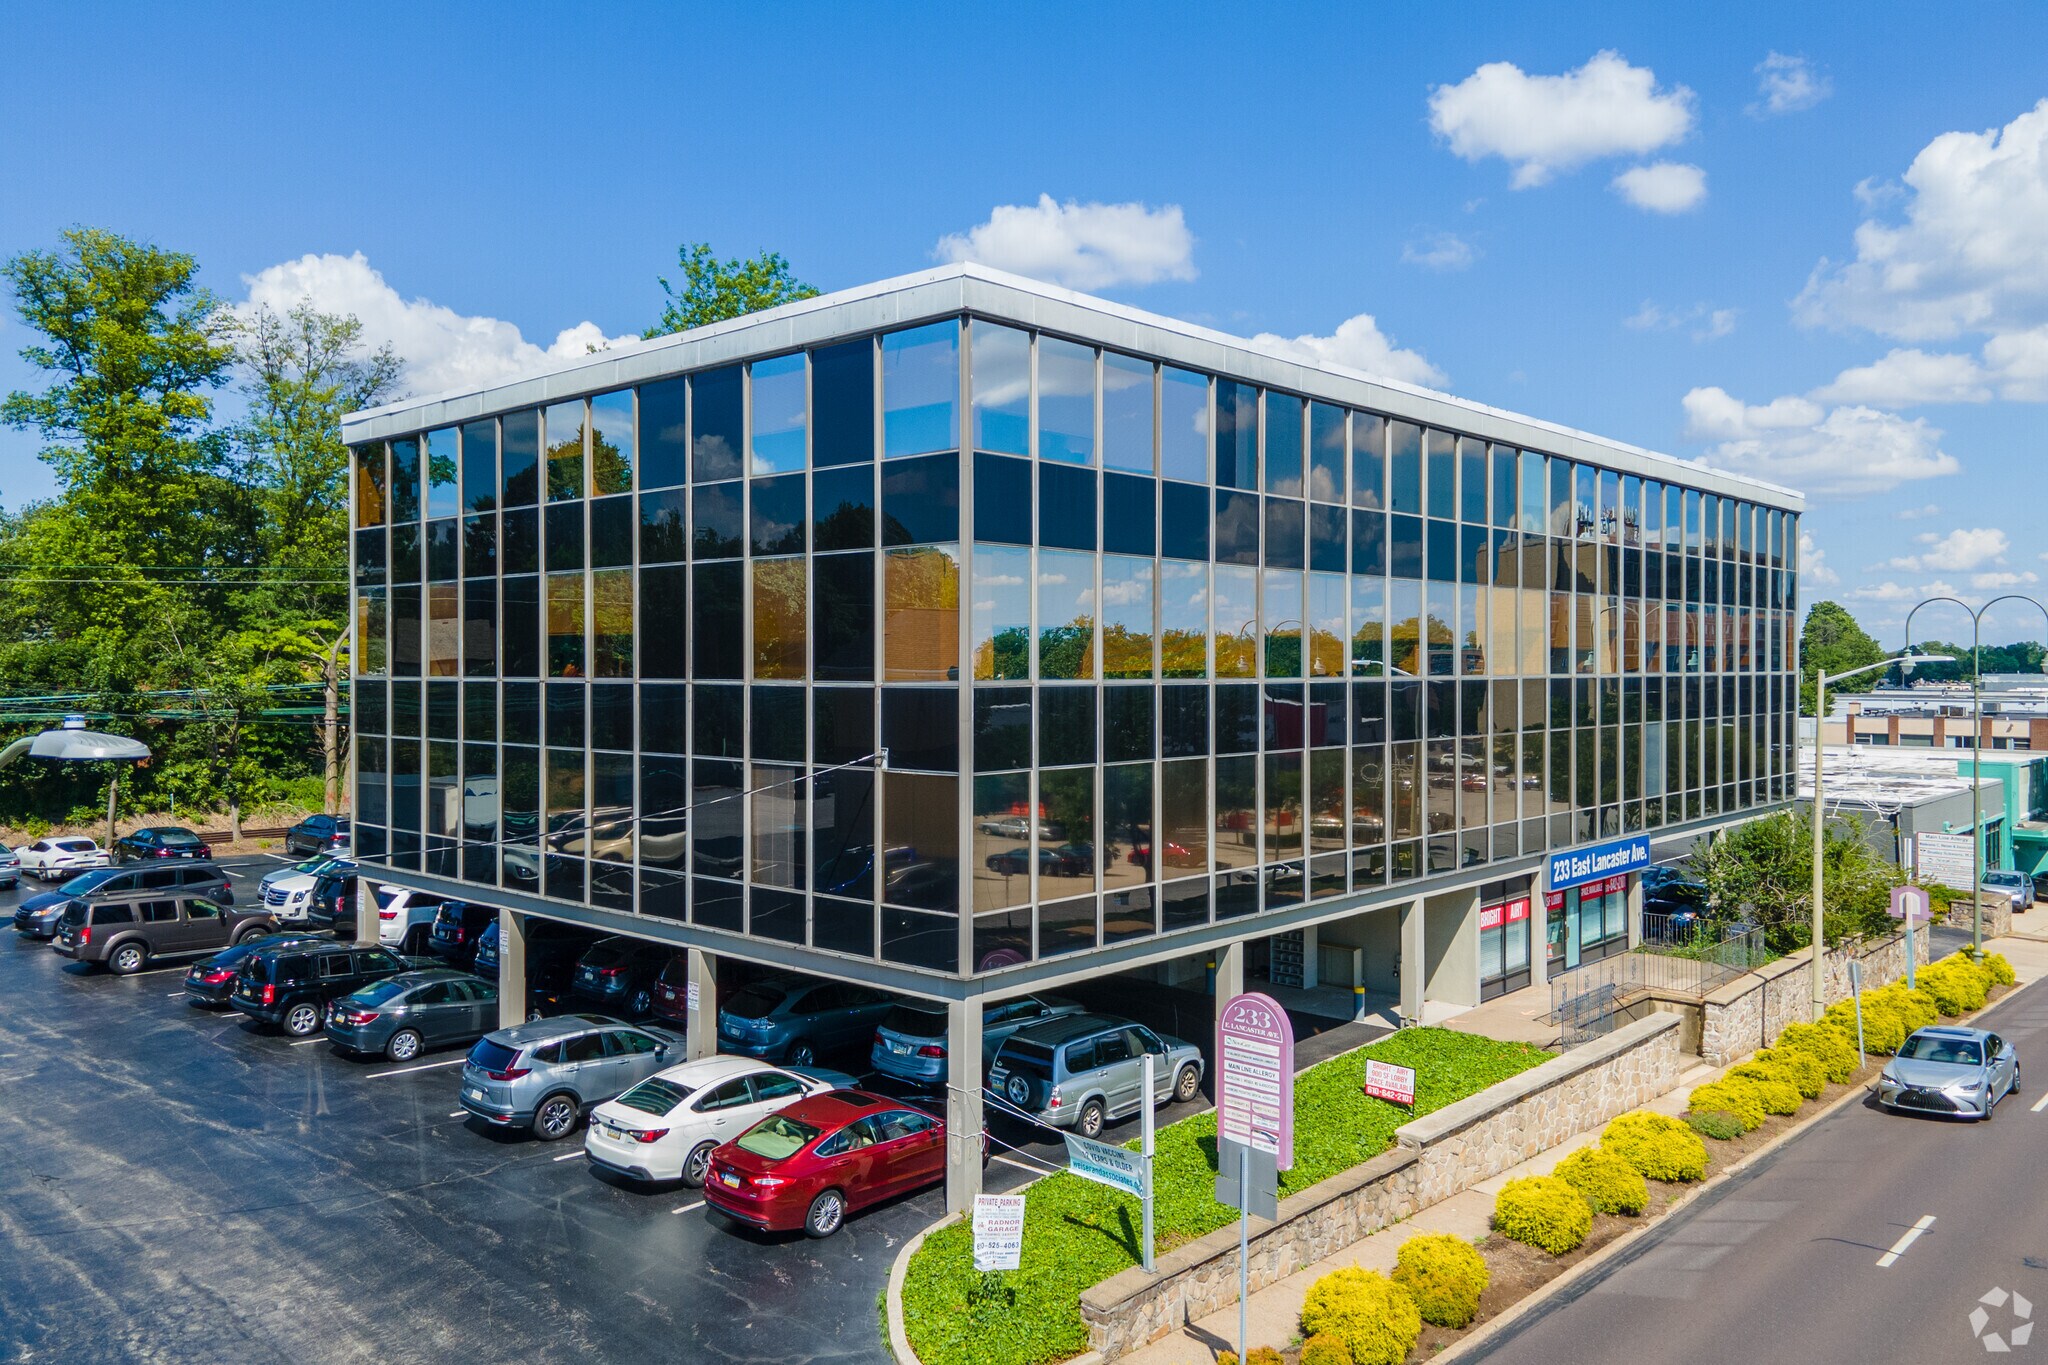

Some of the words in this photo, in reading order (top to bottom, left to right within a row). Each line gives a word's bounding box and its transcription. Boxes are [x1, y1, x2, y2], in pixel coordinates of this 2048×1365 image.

[1553, 859, 1570, 883] 233
[1572, 855, 1590, 878] East
[1592, 848, 1630, 873] Lancaster
[1631, 843, 1647, 863] Ave.
[1481, 907, 1501, 928] BRIGHT
[1510, 901, 1524, 920] AIRY
[1234, 1006, 1271, 1028] 233
[1231, 1023, 1266, 1036] LANCASTER
[1267, 1031, 1280, 1039] AVE.
[1228, 1062, 1240, 1070] MAIN
[1252, 1068, 1276, 1078] ALLERGY
[1083, 1142, 1101, 1153] COVID
[1101, 1147, 1126, 1160] VACCINE
[1115, 1161, 1133, 1172] OLDER
[978, 1198, 998, 1206] PRIVATE
